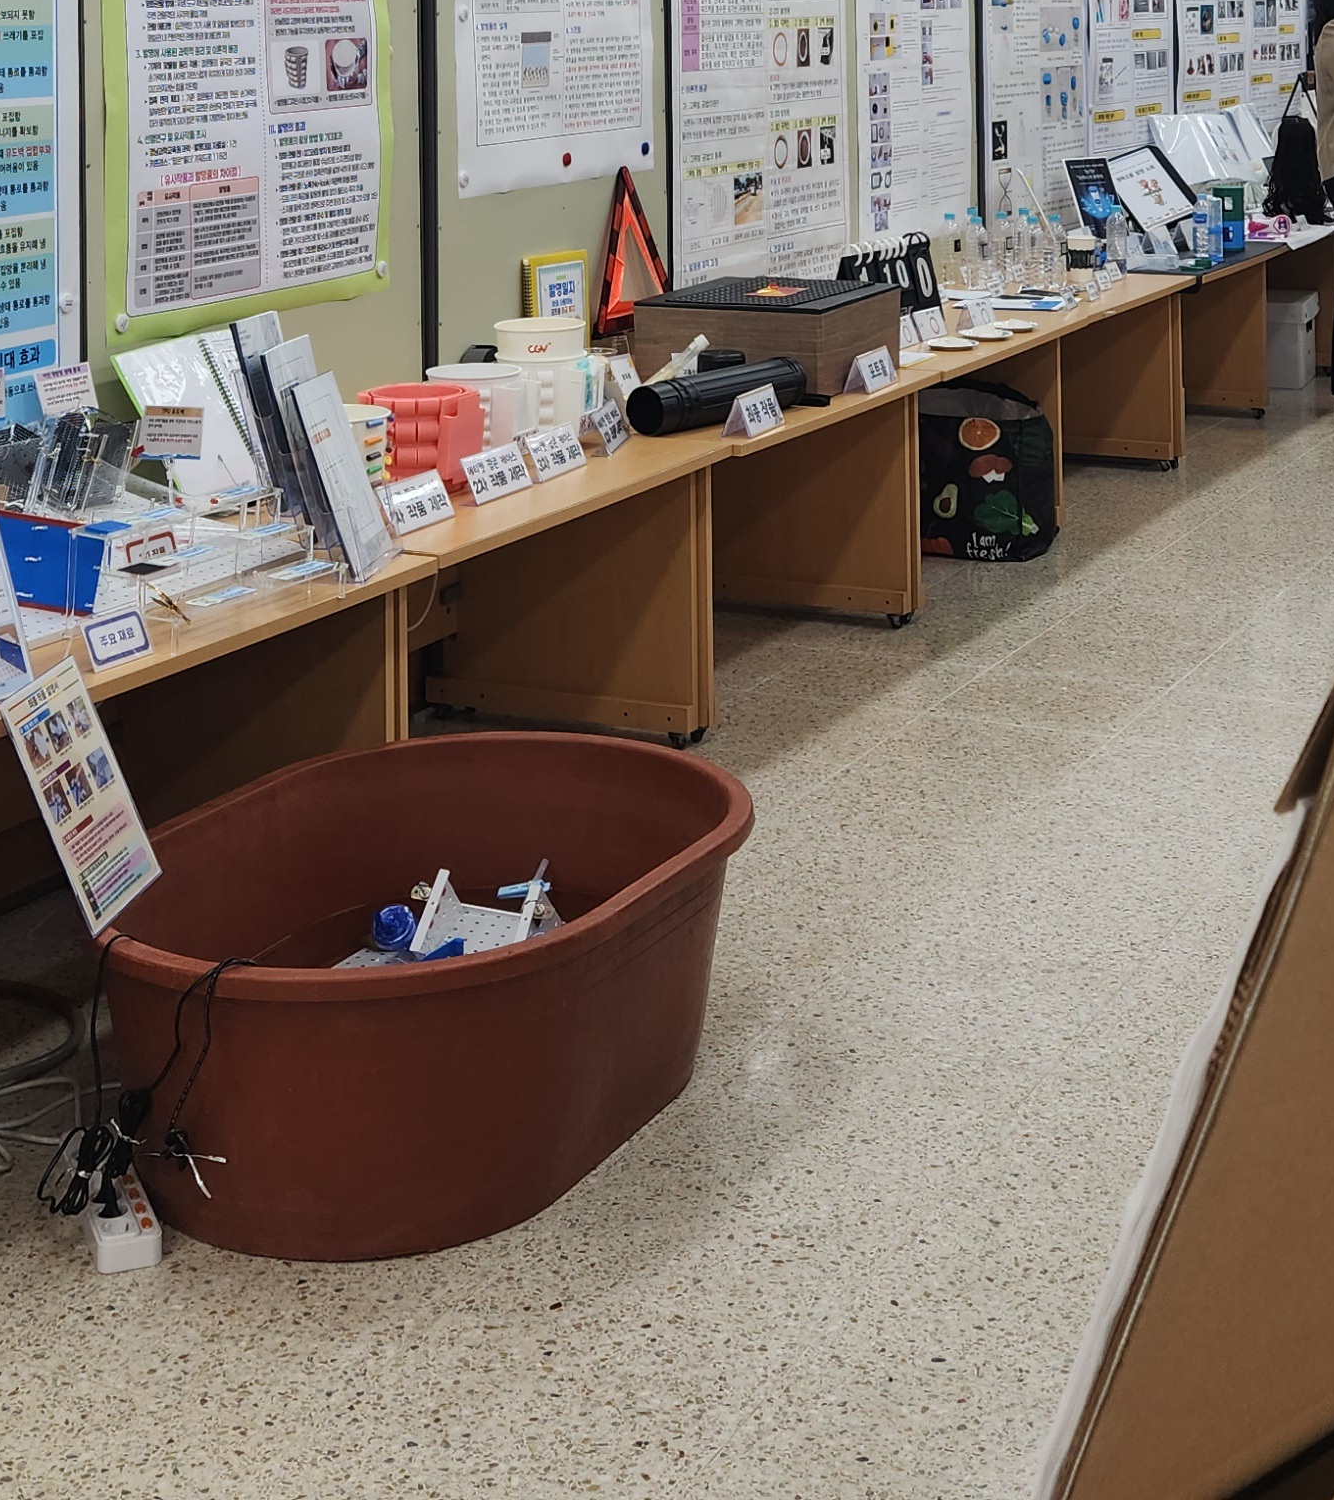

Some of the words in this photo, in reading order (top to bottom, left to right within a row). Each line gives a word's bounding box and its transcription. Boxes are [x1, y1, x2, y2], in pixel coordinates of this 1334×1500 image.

[19, 345, 41, 366] 효과
[527, 343, 549, 354] CGV
[868, 358, 888, 379] 포트홀
[746, 403, 762, 425] 최종
[761, 397, 778, 419] 작품
[551, 449, 567, 467] 작품
[567, 443, 583, 463] 제작
[490, 470, 509, 492] 작품
[509, 463, 527, 486] 제작
[406, 503, 428, 520] 작품
[430, 493, 450, 514] 제작
[978, 533, 997, 547] am
[966, 541, 1012, 561] fresh!
[99, 633, 118, 648] 주요
[118, 626, 136, 642] 재료
